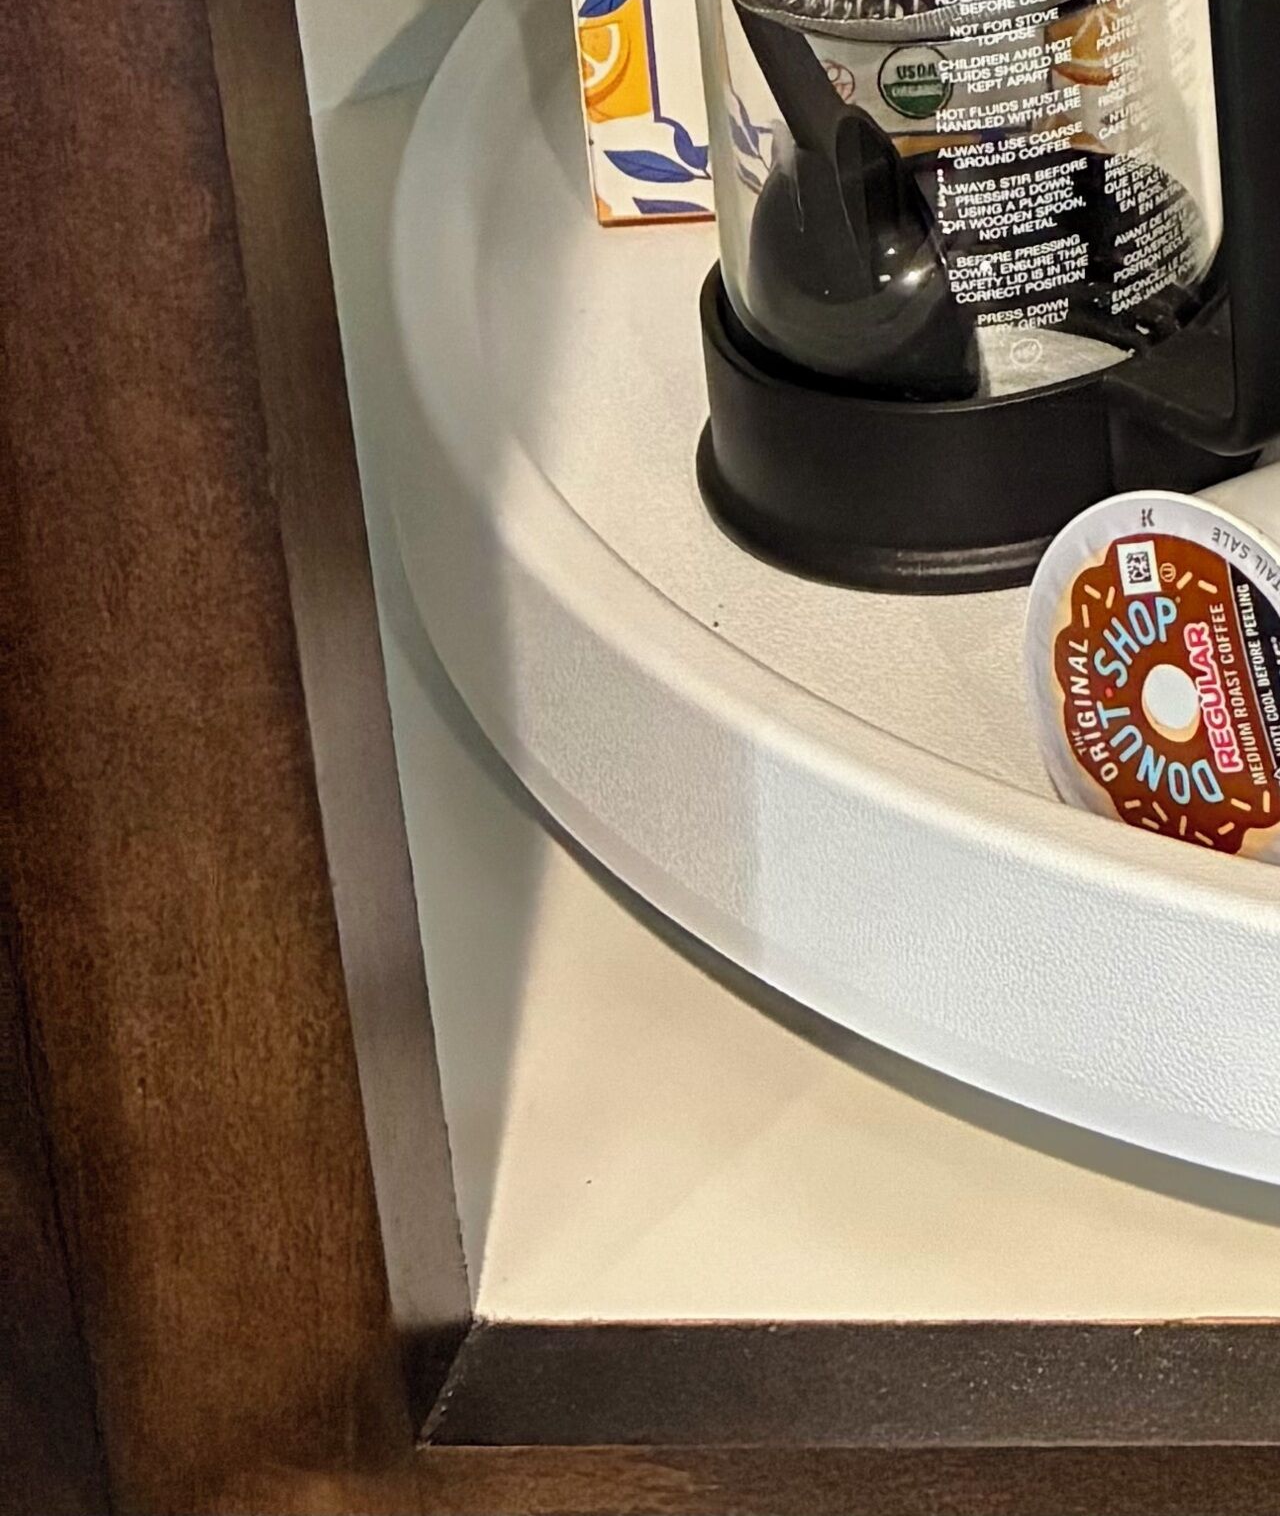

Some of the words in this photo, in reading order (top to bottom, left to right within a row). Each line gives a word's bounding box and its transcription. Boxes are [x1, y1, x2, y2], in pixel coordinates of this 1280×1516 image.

[950, 22, 979, 37] NOT
[983, 18, 1012, 33] FOR
[1015, 7, 1059, 27] STOVE
[938, 51, 1010, 72] CHILDREN
[1012, 45, 1042, 61] AND
[1045, 36, 1073, 54] HOT
[939, 67, 991, 84] FLUIDS
[993, 56, 1051, 77] SHOULD
[1054, 49, 1073, 65] BE
[967, 79, 1003, 94] KEPT
[1006, 68, 1050, 88] APART
[936, 106, 967, 122] HOT
[969, 100, 1019, 117] FLUIDS
[1022, 90, 1061, 108] MUST
[1064, 84, 1081, 98] BE
[936, 115, 1005, 133] HANDLED
[1007, 108, 1043, 124] WITH
[1046, 96, 1082, 115] CARE
[937, 141, 995, 159] ALWAYS
[998, 135, 1026, 151] USE
[1029, 121, 1083, 145] COARSE
[953, 151, 1016, 170] GROUND
[1019, 137, 1073, 159] COFFEE
[939, 179, 997, 196] ALWAYS
[1000, 173, 1032, 189] STIR
[1035, 157, 1088, 181] BEFORE
[955, 187, 1026, 207] PRESSING
[1029, 175, 1075, 195] DOWN,
[958, 202, 1003, 219] USING
[1005, 201, 1016, 212] A
[1019, 187, 1074, 209] PLASTIC
[969, 210, 1032, 229] WOODEN
[1035, 196, 1087, 217] SPOON,
[979, 227, 1011, 241] NOT
[1013, 217, 1058, 235] METAL
[956, 250, 1013, 268] BEFORE
[1015, 234, 1081, 260] PRESSING
[1000, 255, 1054, 275] ENSURE
[1058, 242, 1089, 261] THAT
[950, 276, 1003, 293] SAFETY
[1006, 272, 1028, 286] LID
[1031, 268, 1043, 280] IS
[1047, 264, 1061, 277] IN
[1064, 254, 1089, 272] THE
[955, 286, 1021, 304] CORRECT
[1025, 268, 1086, 295] POSITION
[977, 308, 1024, 325] PRESS
[1027, 297, 1069, 316] DOWN
[1017, 309, 1069, 331] GENTLY
[1211, 526, 1250, 560] SALE
[1236, 583, 1259, 636] PEELING
[1094, 596, 1178, 688] SHOP
[1209, 603, 1235, 665] COFFEE
[1248, 639, 1271, 687] BEFORE
[1068, 639, 1119, 782] ORIGINAL
[1183, 622, 1243, 773] REGULAR
[1224, 669, 1249, 718] ROAST
[1261, 688, 1280, 722] COOL
[1097, 700, 1224, 805] DONUT
[1237, 722, 1268, 786] MEDIUM
